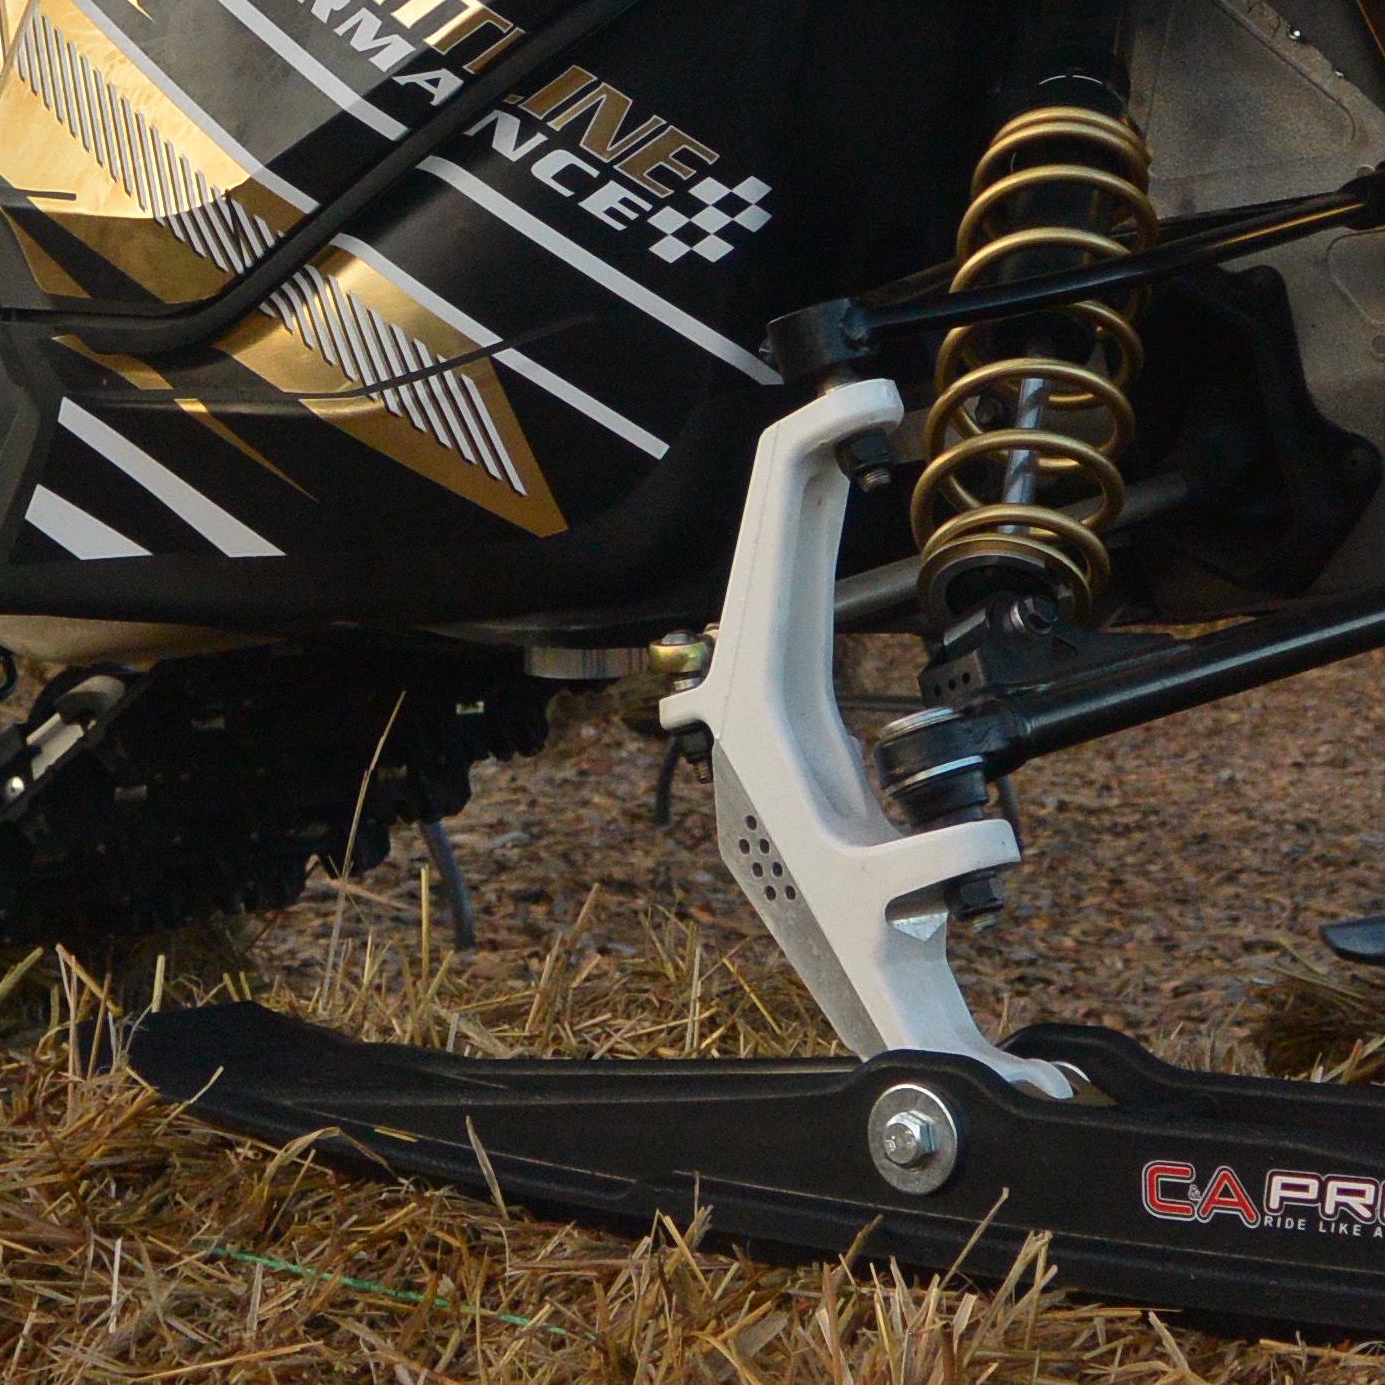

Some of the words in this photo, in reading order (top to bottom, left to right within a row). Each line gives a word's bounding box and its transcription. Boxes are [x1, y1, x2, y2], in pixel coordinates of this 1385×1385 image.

[1264, 1215, 1307, 1231] RIDE
[1318, 1220, 1362, 1237] LIKE
[1372, 1226, 1384, 1239] A
